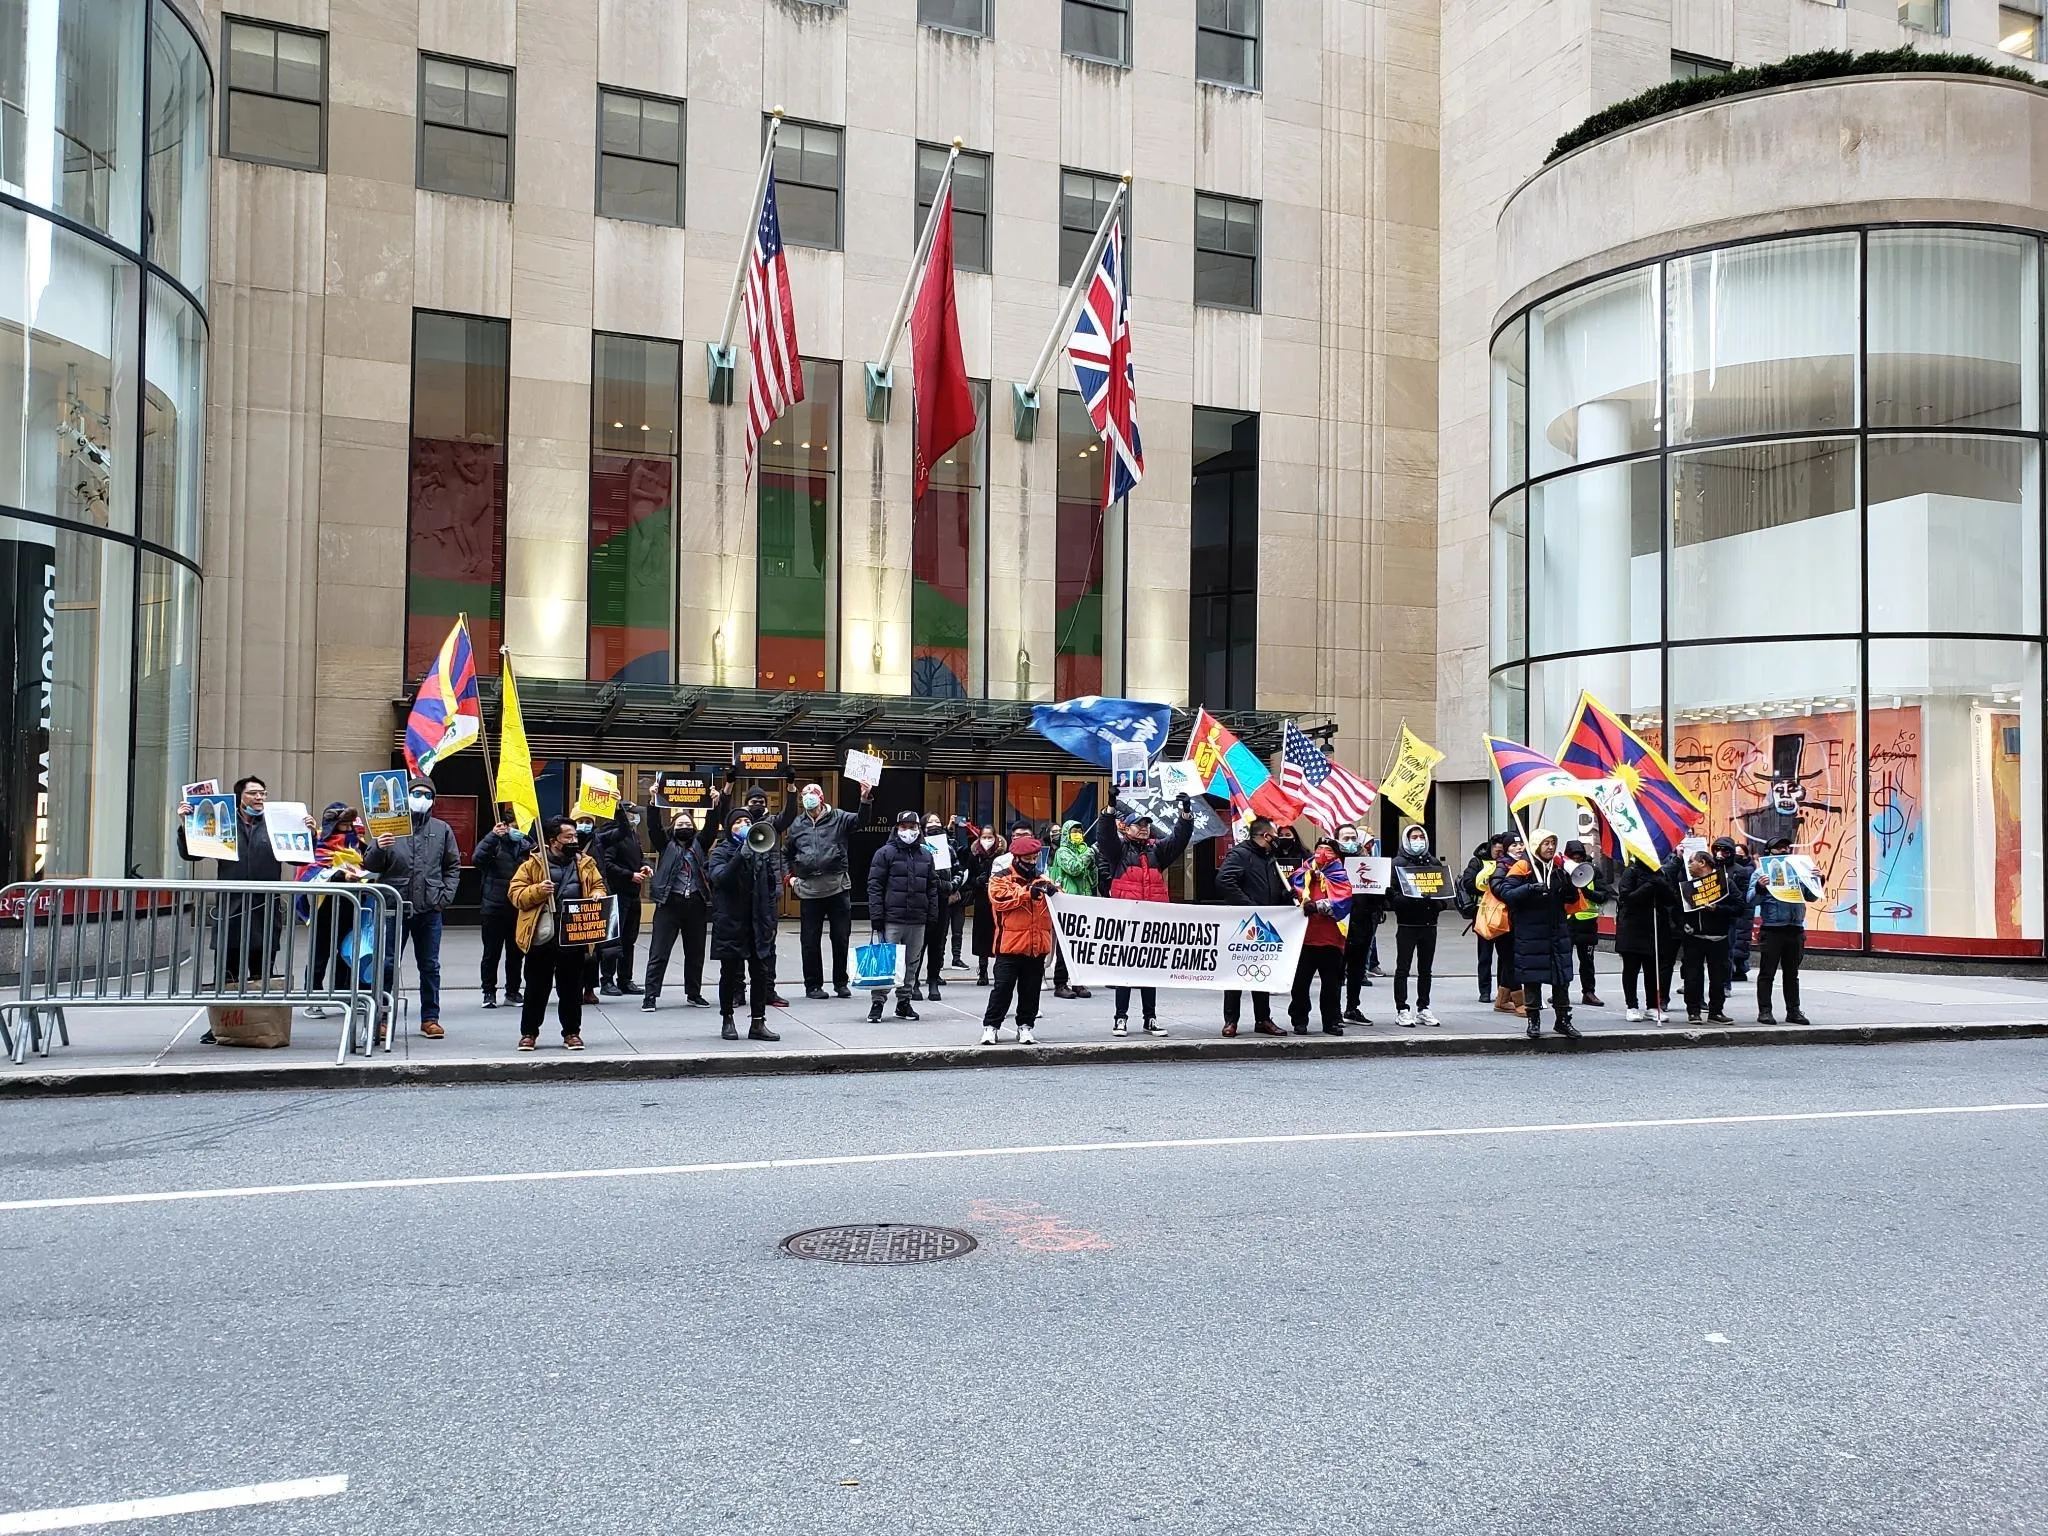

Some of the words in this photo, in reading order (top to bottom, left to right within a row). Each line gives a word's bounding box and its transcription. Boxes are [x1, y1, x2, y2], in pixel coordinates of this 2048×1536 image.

[877, 816, 888, 824] 20
[580, 902, 602, 912] FOLLOW
[572, 913, 582, 922] THE
[566, 922, 578, 932] LEAD
[583, 919, 607, 930] SUPPORT
[1057, 911, 1091, 939] NBC:
[1094, 917, 1140, 943] DON'T
[1141, 921, 1220, 946] BROADCAST
[568, 931, 587, 941] HUMAN
[587, 928, 606, 939] RIGHTS
[1227, 943, 1283, 952] GENOCIDE
[1069, 939, 1097, 965] THE
[1099, 943, 1168, 970] GENOCIDE
[1171, 948, 1219, 972] GAMES
[1231, 953, 1259, 961] Beijing
[1260, 953, 1279, 961] 2022
